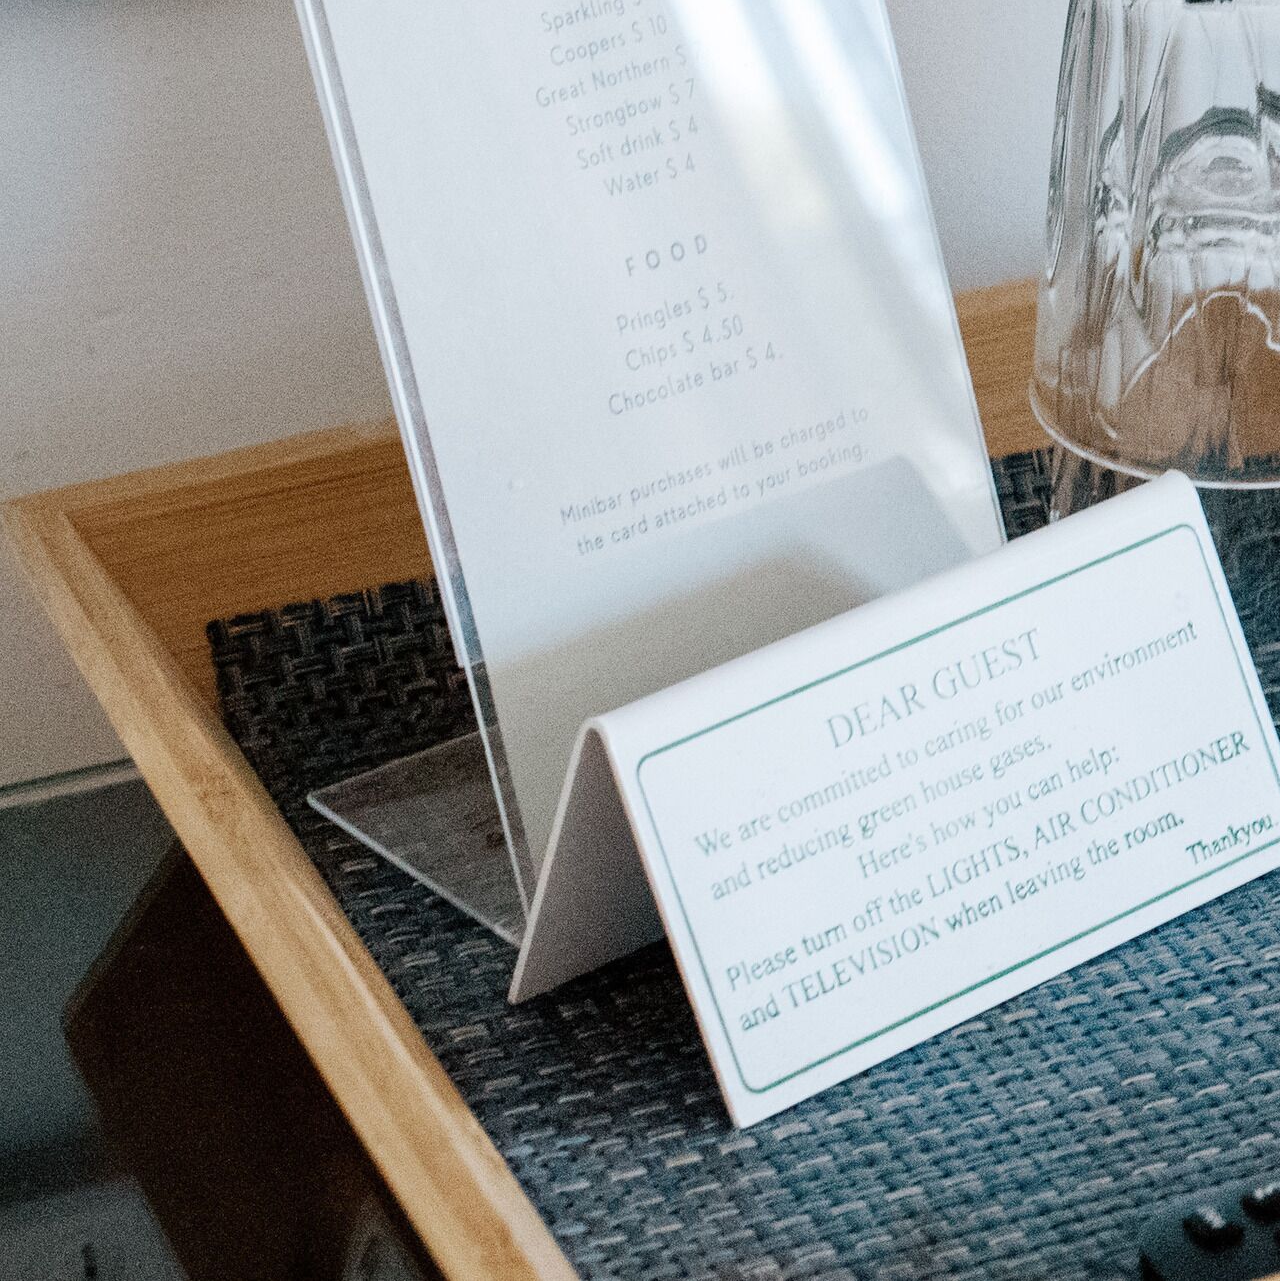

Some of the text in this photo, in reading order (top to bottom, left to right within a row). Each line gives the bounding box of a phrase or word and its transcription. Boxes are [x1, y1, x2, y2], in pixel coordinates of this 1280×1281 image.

[550, 33, 626, 67] Coopers
[649, 15, 668, 37] 10
[535, 80, 586, 109] Great
[591, 55, 670, 92] Northern
[565, 95, 662, 137] Strongbow
[577, 142, 614, 171] Soft
[620, 127, 664, 157] drink
[603, 169, 659, 197] Water
[625, 234, 707, 277] FOOD
[616, 300, 692, 337] Pringles
[625, 343, 677, 372] Chips
[702, 314, 744, 345] 4.50
[608, 371, 704, 416] Chocolate
[710, 359, 739, 381] bar
[559, 405, 869, 526] Minibar purchases will be charged to
[576, 443, 870, 556] the card attached to your booking.
[826, 628, 1041, 749] DEAR GUEST
[694, 621, 1198, 858] We are committed to caring for our environment
[710, 734, 1052, 901] and reducing green house gases.
[857, 744, 1120, 879] Here's how you can help:
[725, 730, 1250, 992] Please turn off the LIGHTS, AIR CONDITIONER
[739, 811, 1184, 1032] and TELEVISION when leaving the room.
